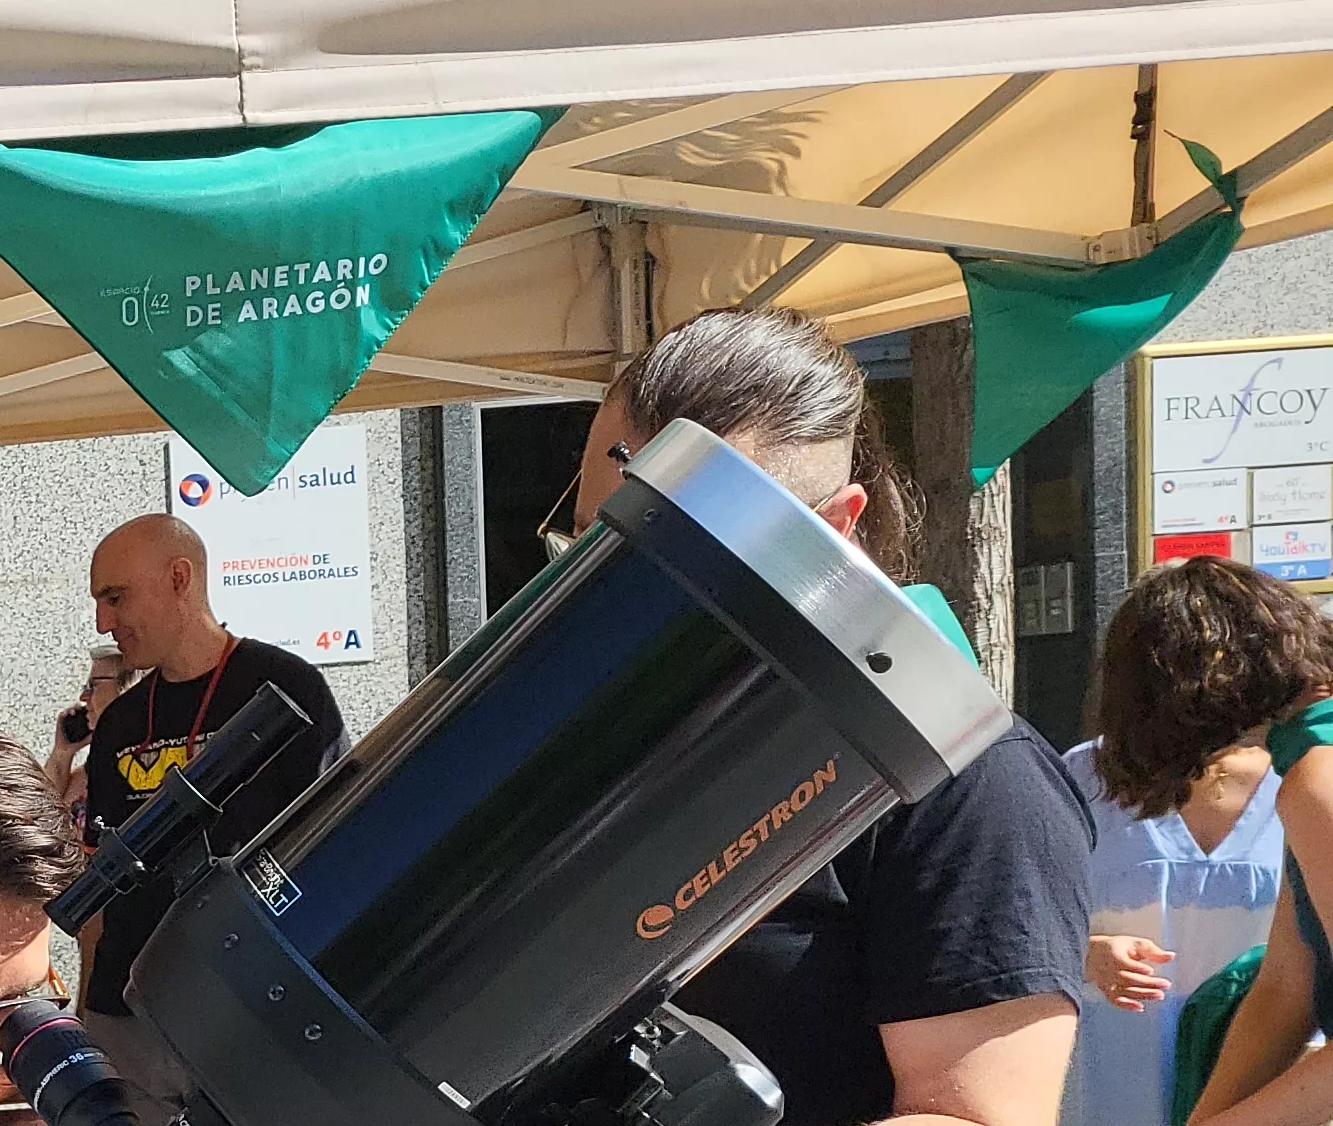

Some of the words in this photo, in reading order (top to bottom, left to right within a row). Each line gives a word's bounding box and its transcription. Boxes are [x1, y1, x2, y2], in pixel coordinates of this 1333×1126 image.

[185, 252, 389, 297] PLANETARIO
[150, 293, 170, 309] 42
[186, 302, 222, 328] DE
[237, 281, 371, 324] ARAGÓN
[1164, 387, 1331, 425] FRANCOY
[298, 464, 357, 490] salud
[222, 552, 309, 573] PREVENCIÓN
[312, 553, 331, 566] DE
[223, 570, 280, 588] RIESGOS
[282, 565, 359, 583] LABORALES
[673, 758, 838, 911] CELESTRON
[261, 881, 289, 908] XLT
